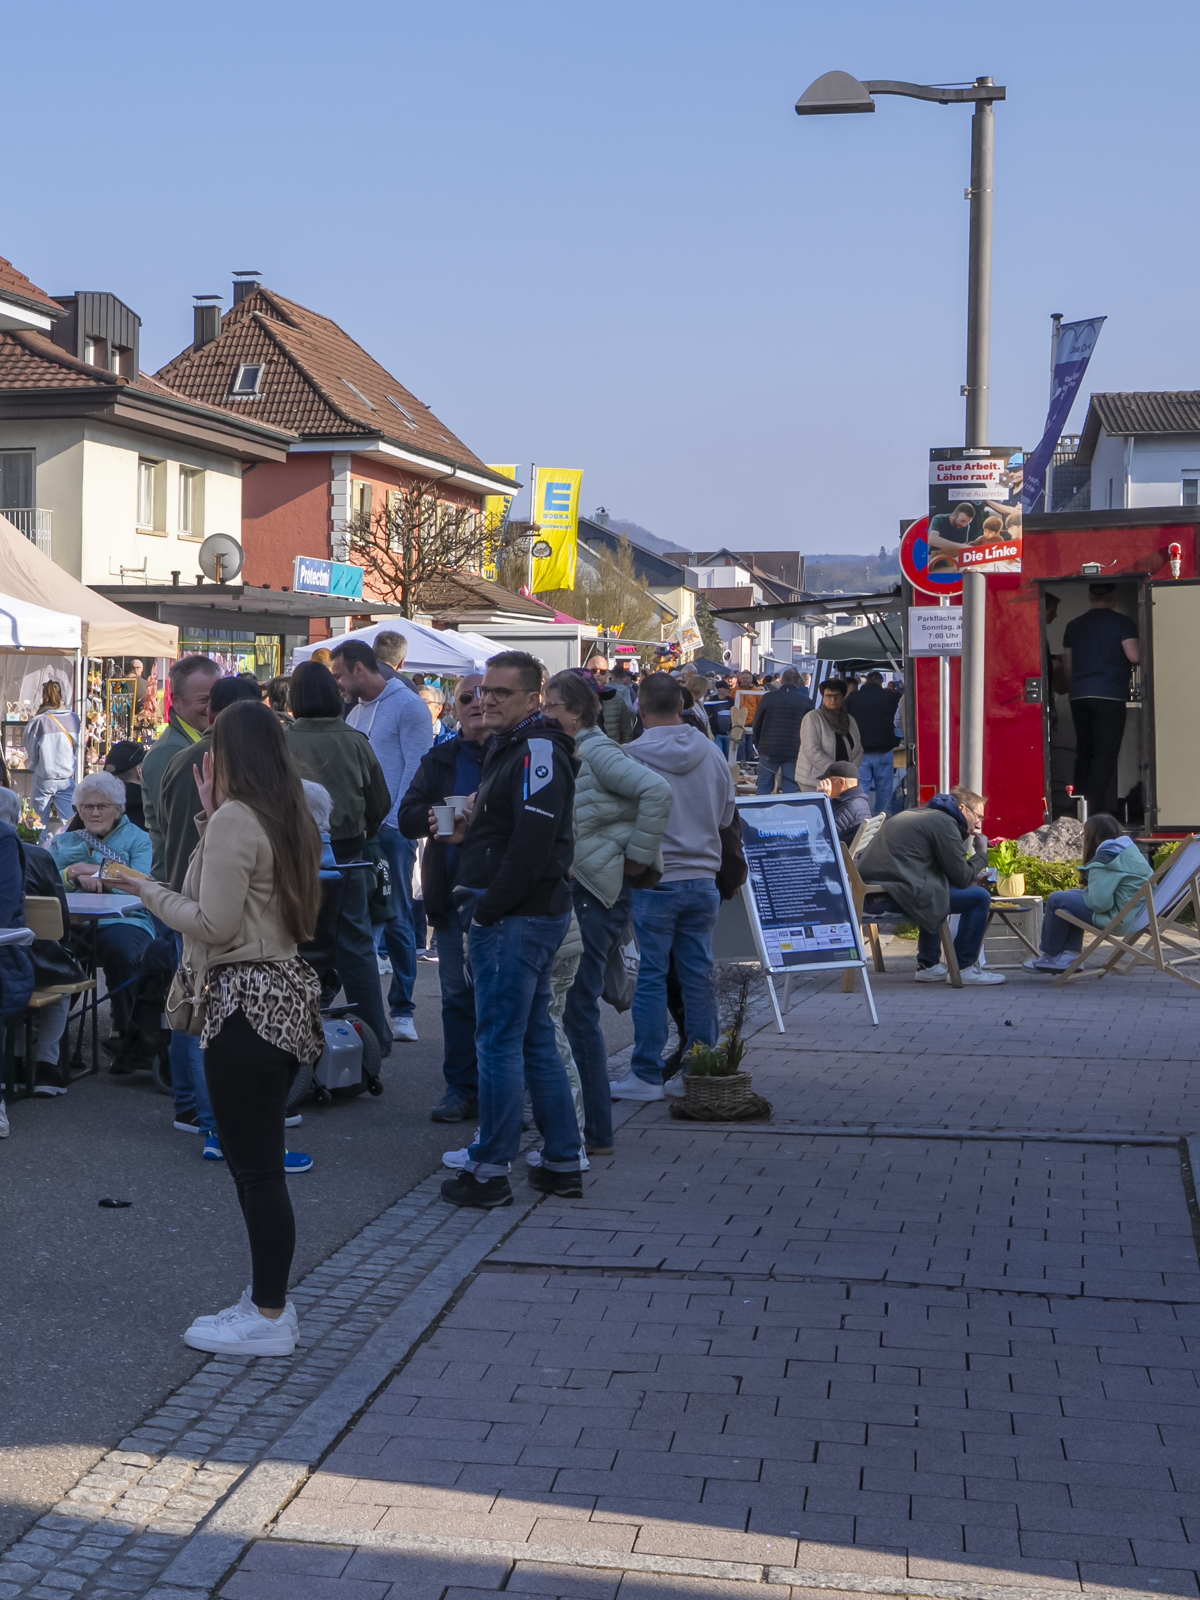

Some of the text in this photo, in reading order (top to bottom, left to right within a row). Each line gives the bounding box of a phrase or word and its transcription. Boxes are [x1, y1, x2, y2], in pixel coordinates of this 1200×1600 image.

[937, 462, 1001, 471] Gute Arbeit.
[937, 472, 996, 482] Löhne rauf.
[543, 482, 573, 512] E
[951, 490, 1006, 498] Ohne Ausrede.
[963, 545, 1018, 563] Die Linke
[757, 824, 810, 838] Gewinnspiel
